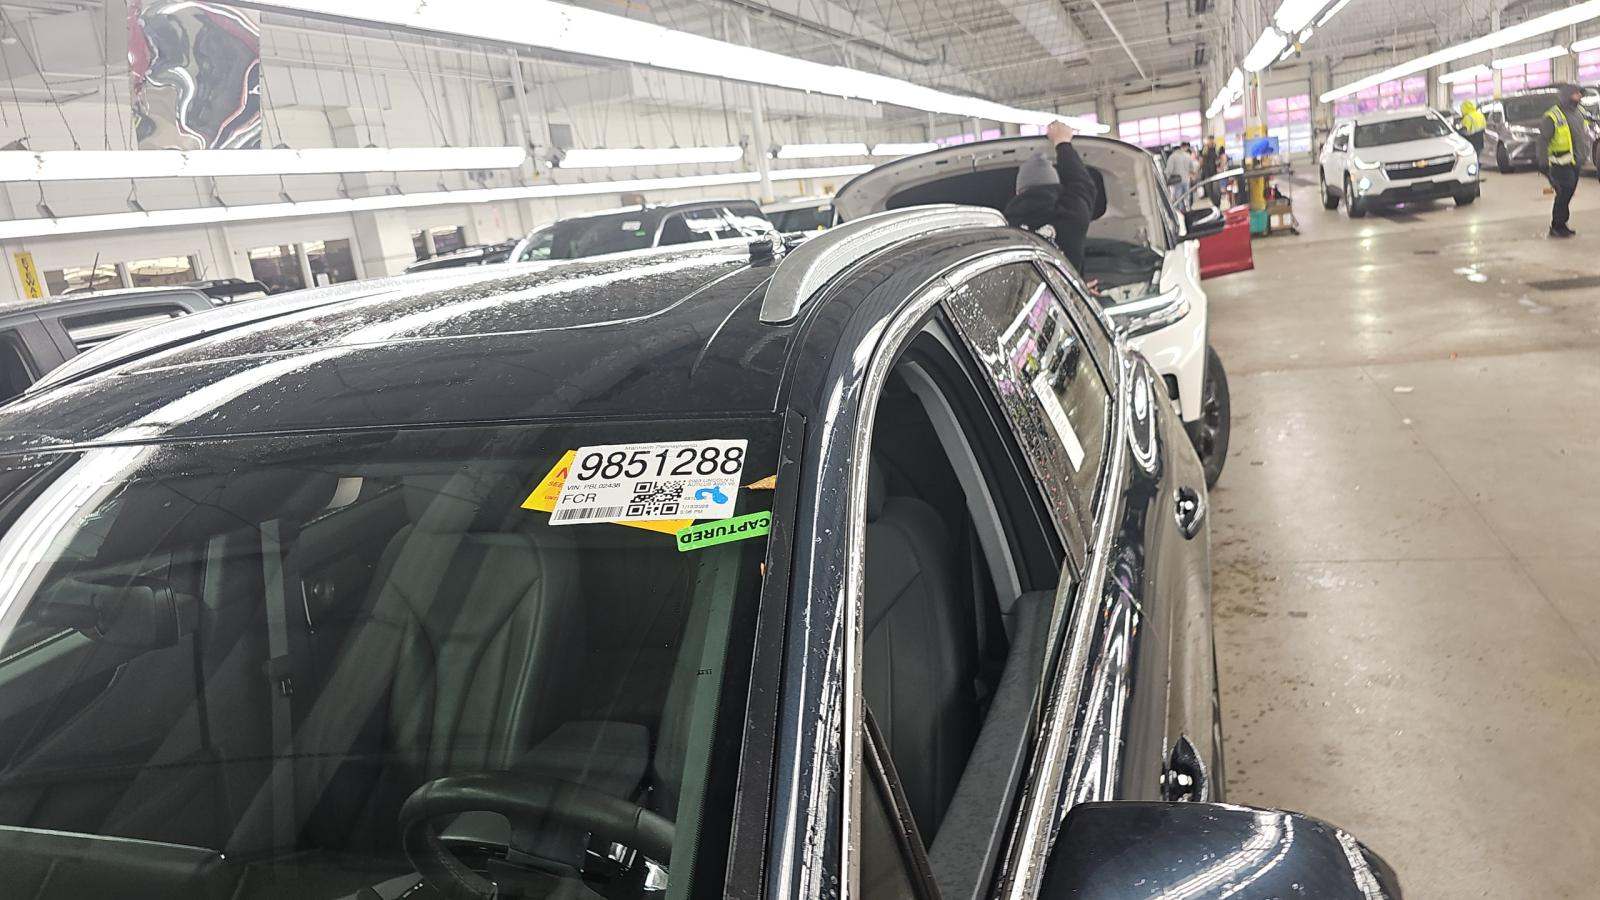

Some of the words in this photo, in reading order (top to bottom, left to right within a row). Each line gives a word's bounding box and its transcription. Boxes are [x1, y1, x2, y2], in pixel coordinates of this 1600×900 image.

[577, 446, 744, 481] 9851288
[561, 493, 597, 504] FCR
[680, 517, 771, 545] CAPTURED
